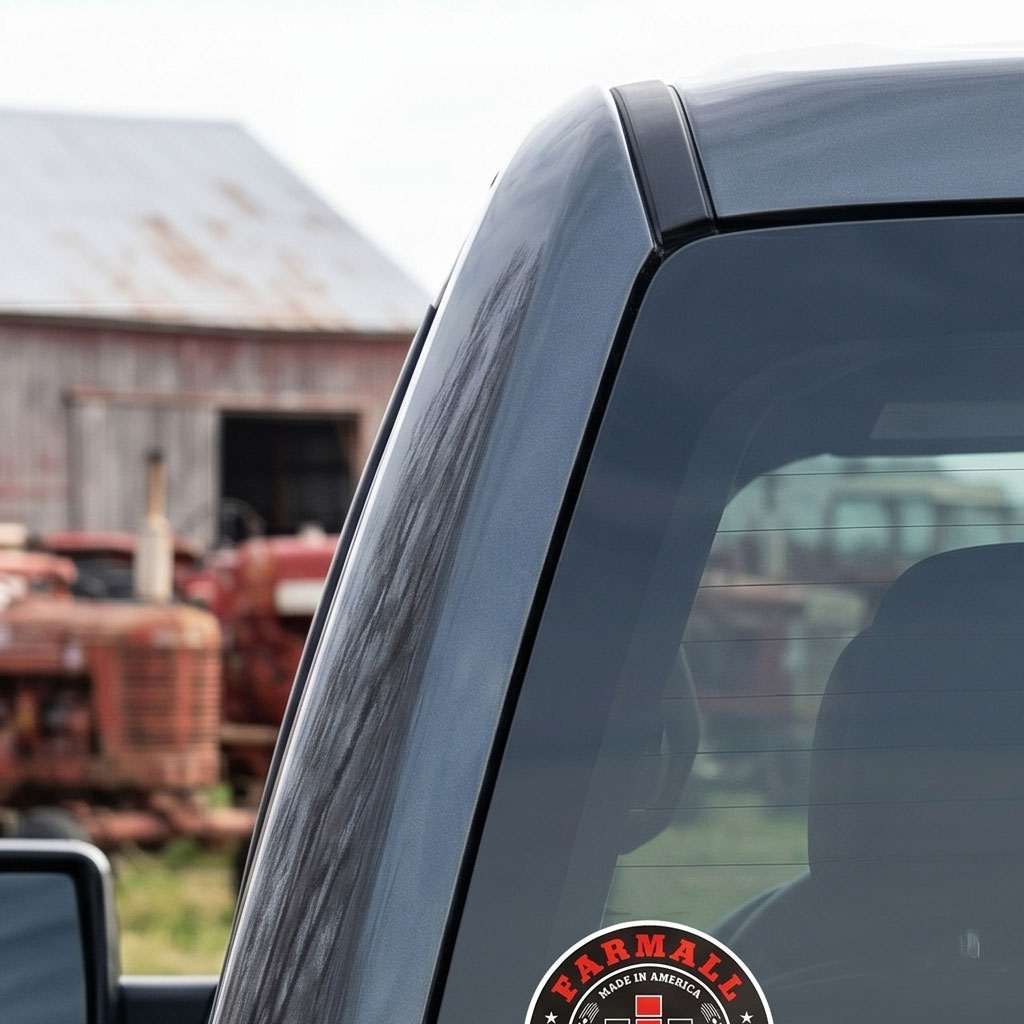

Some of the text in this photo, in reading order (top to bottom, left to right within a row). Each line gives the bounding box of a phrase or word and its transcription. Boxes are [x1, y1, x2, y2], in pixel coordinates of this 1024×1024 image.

[551, 933, 743, 1003] FARMALL
[598, 971, 702, 1000] MADE IN AMERICA
